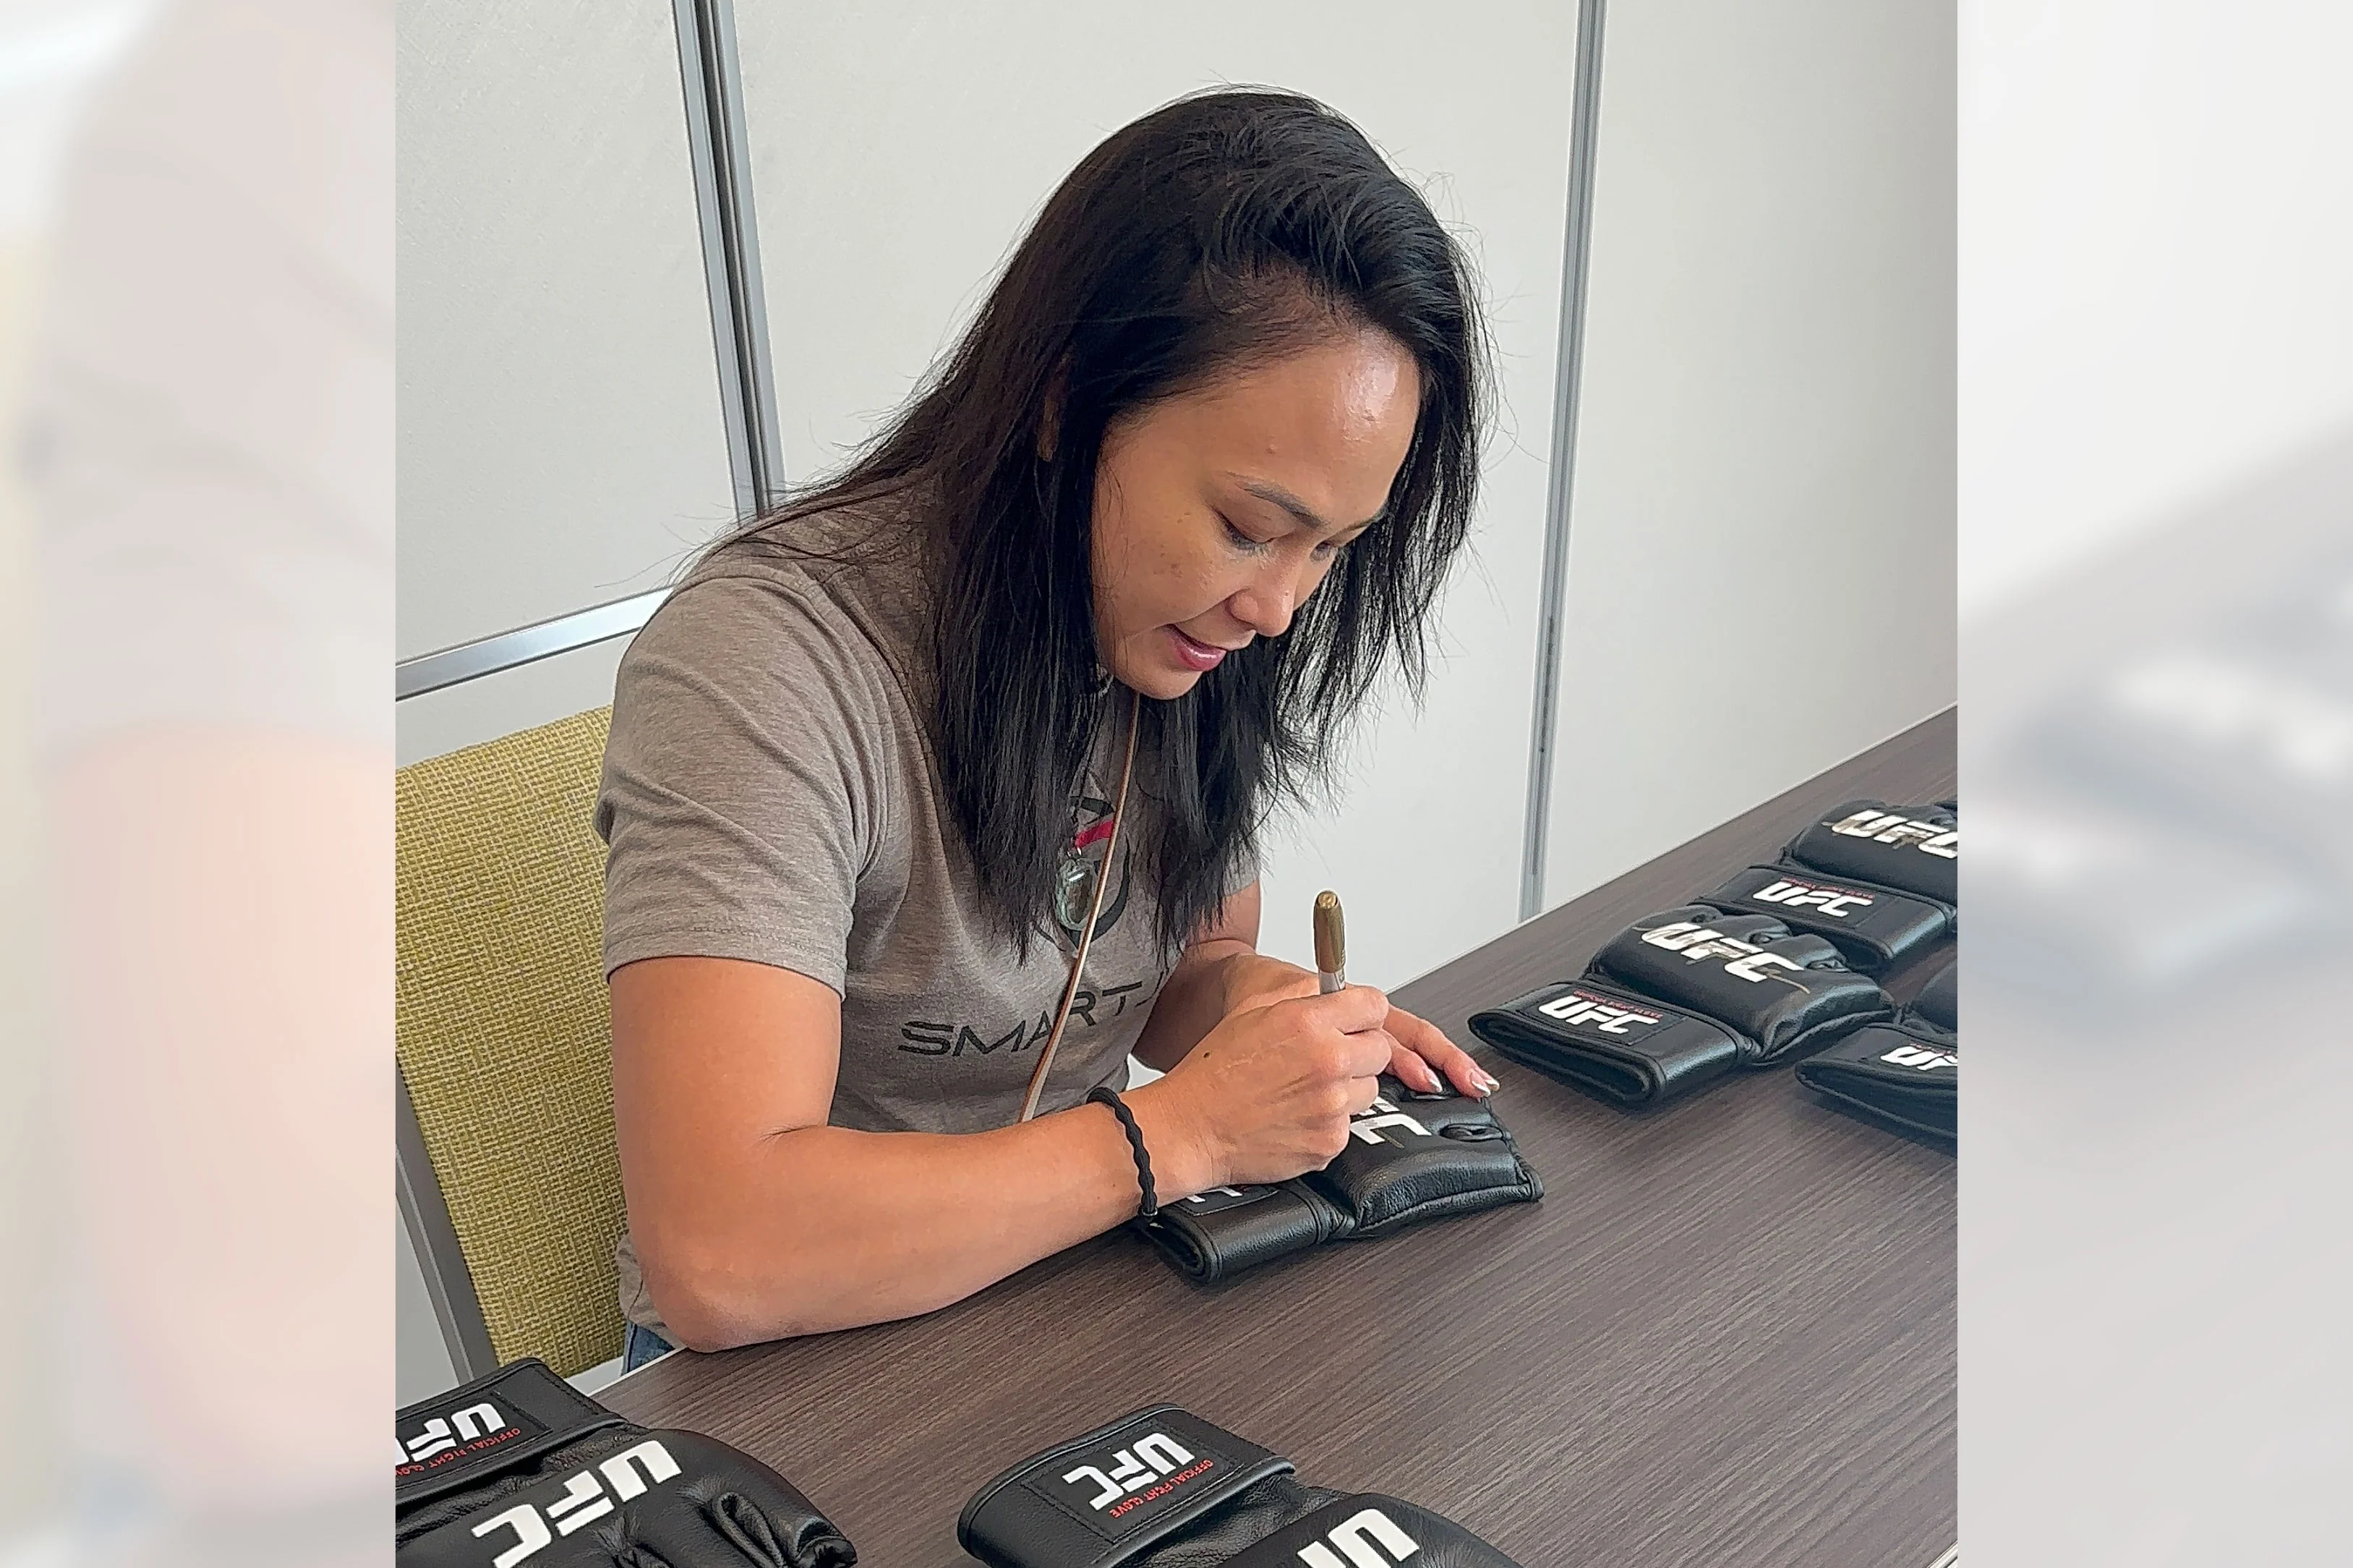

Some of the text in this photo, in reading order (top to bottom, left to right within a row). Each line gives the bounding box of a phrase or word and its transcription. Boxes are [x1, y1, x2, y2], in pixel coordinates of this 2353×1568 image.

[1753, 881, 1874, 917] UFC
[1641, 922, 1805, 983] UFC
[897, 980, 1143, 1056] SMART
[1538, 995, 1660, 1034] UFC
[469, 1427, 521, 1452] OFFICIAL
[1061, 1432, 1195, 1510] UFC
[1109, 1458, 1214, 1518] OFFICIAL FIGHT GLOVE
[471, 1440, 682, 1568] UFC
